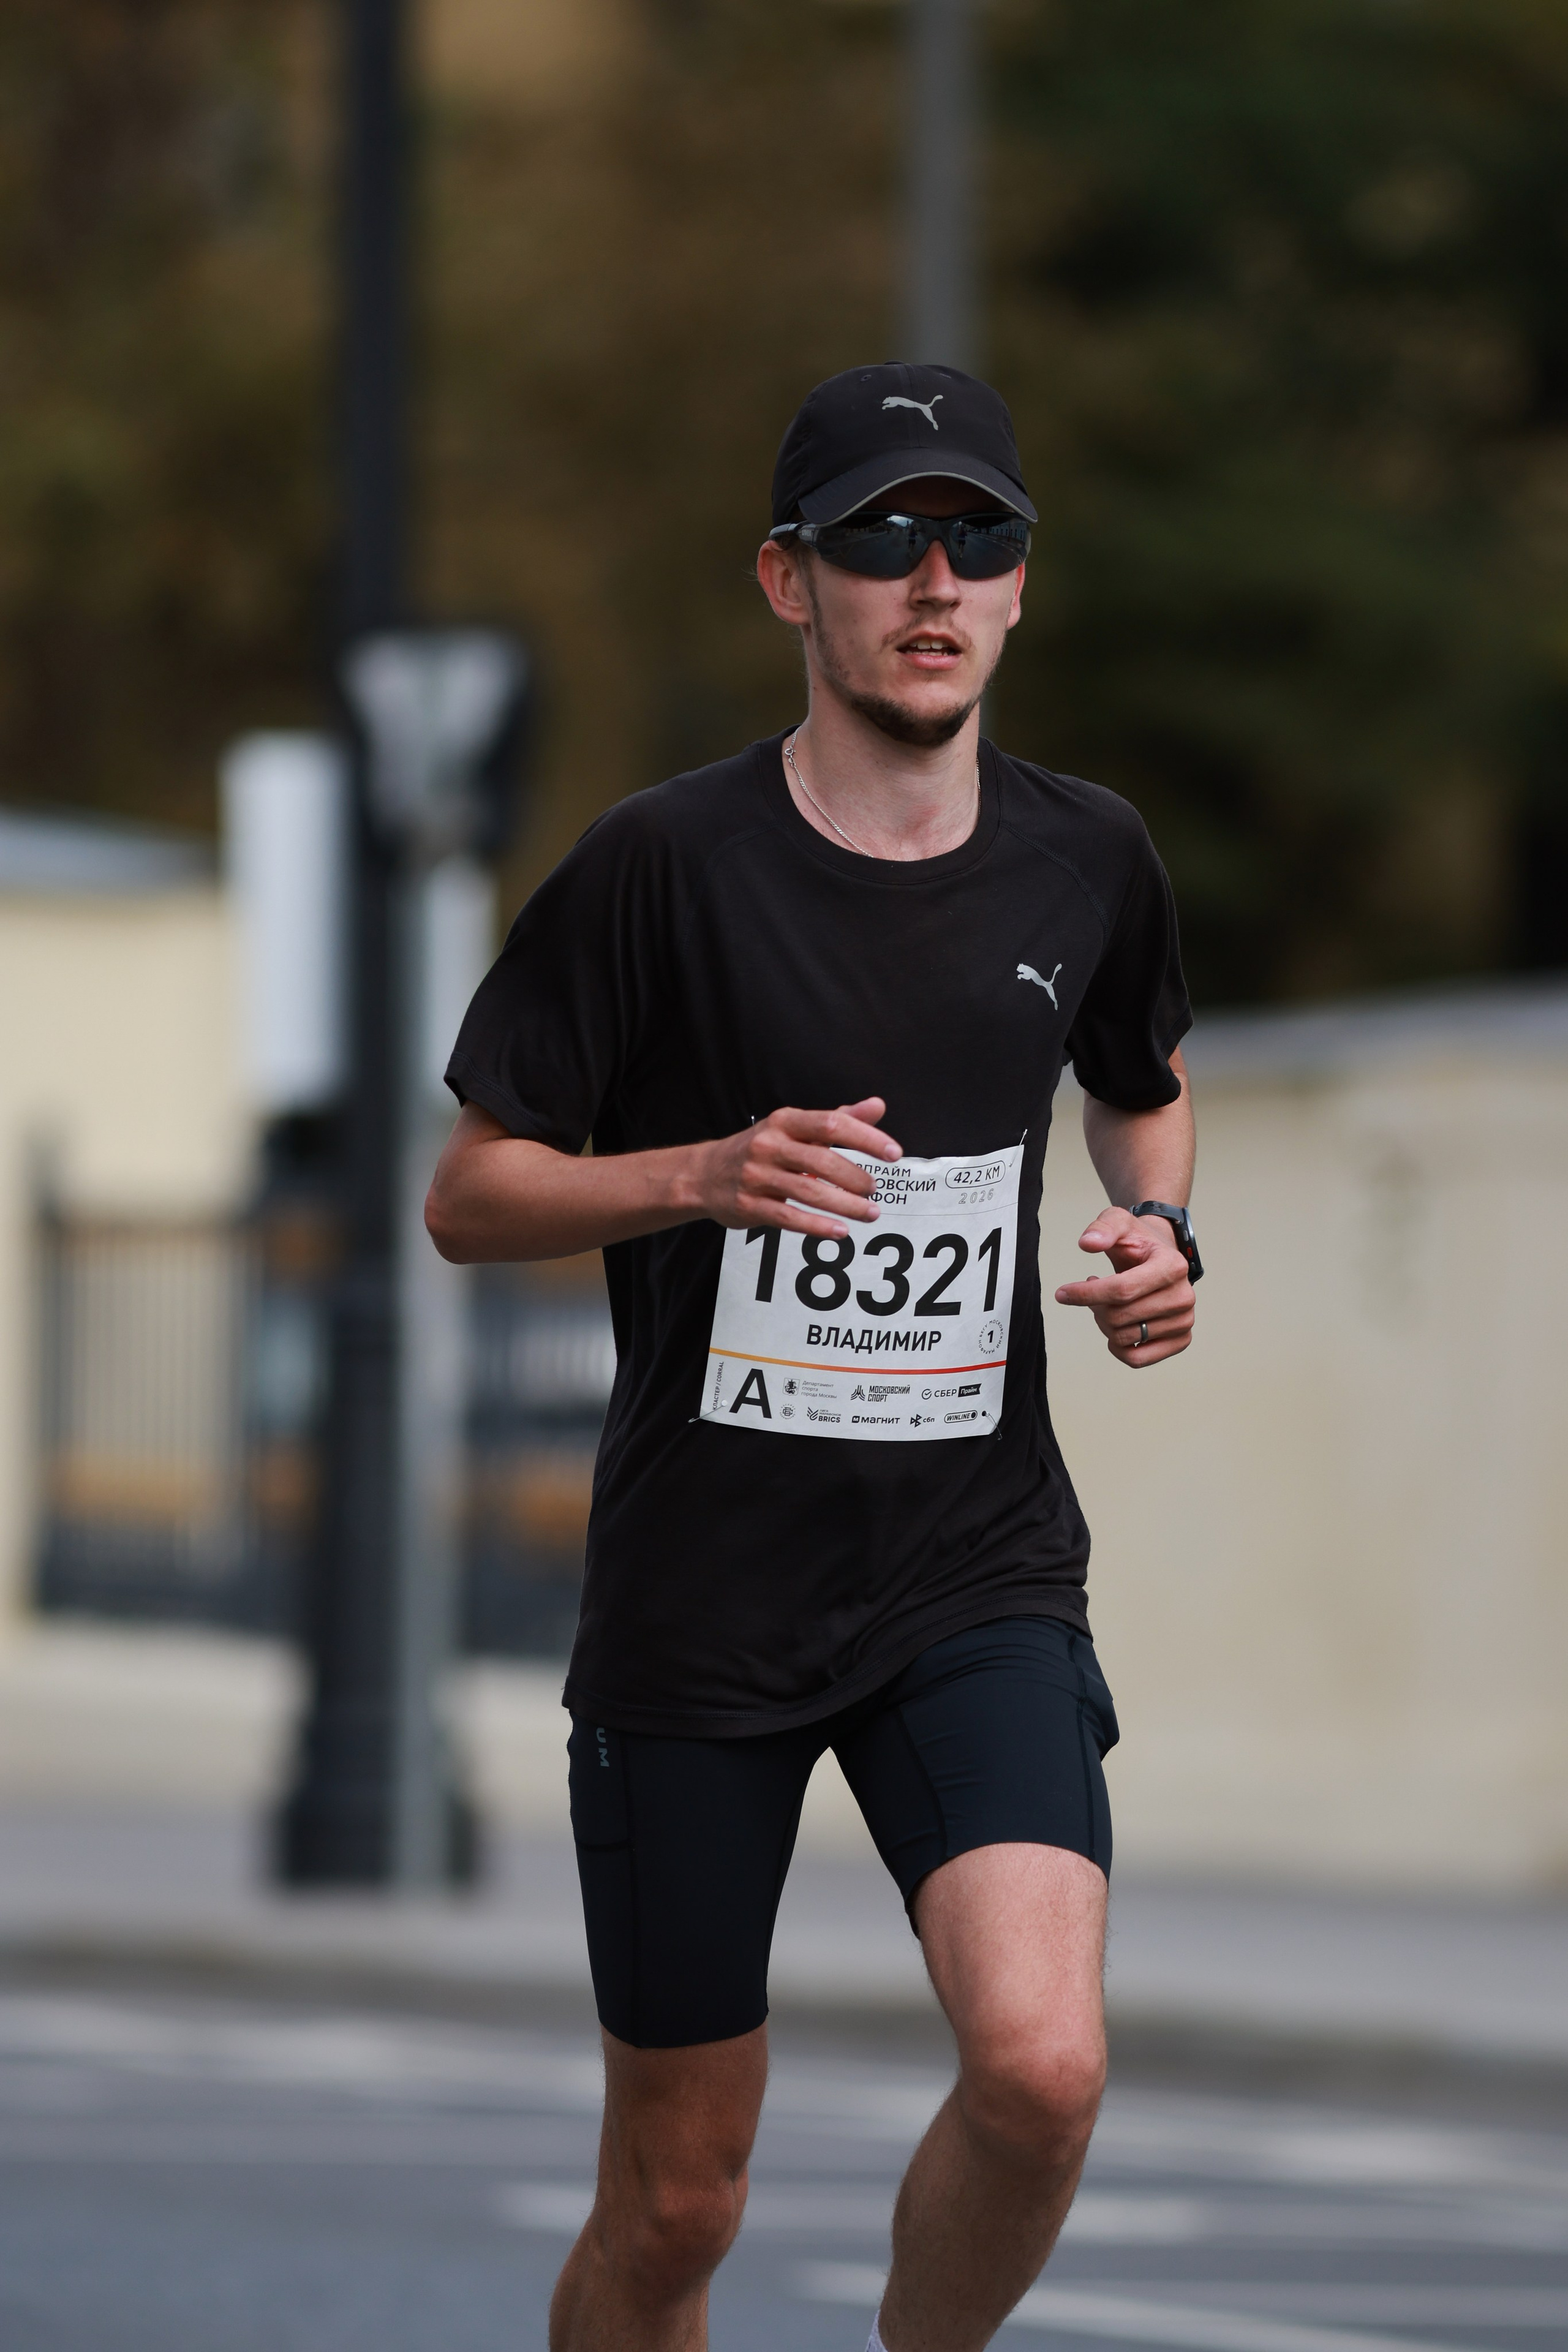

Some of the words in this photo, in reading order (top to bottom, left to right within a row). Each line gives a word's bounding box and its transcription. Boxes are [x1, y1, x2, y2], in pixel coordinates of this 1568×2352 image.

[953, 1170, 982, 1185] 42,2
[985, 1165, 1000, 1180] КМ
[875, 1178, 936, 1191] ОВСКИЙ
[868, 1191, 907, 1205] ФОН
[958, 1188, 994, 1204] 2026
[745, 1226, 1002, 1317] 18321
[806, 1324, 942, 1354] ВЛАДИМИР
[987, 1330, 994, 1343] 1
[729, 1368, 772, 1419] А
[869, 1384, 910, 1394] МОСКОВСКИЙ
[934, 1389, 957, 1397] СБЕР
[867, 1393, 888, 1402] СПОРТ
[946, 1413, 971, 1422] WINLINE
